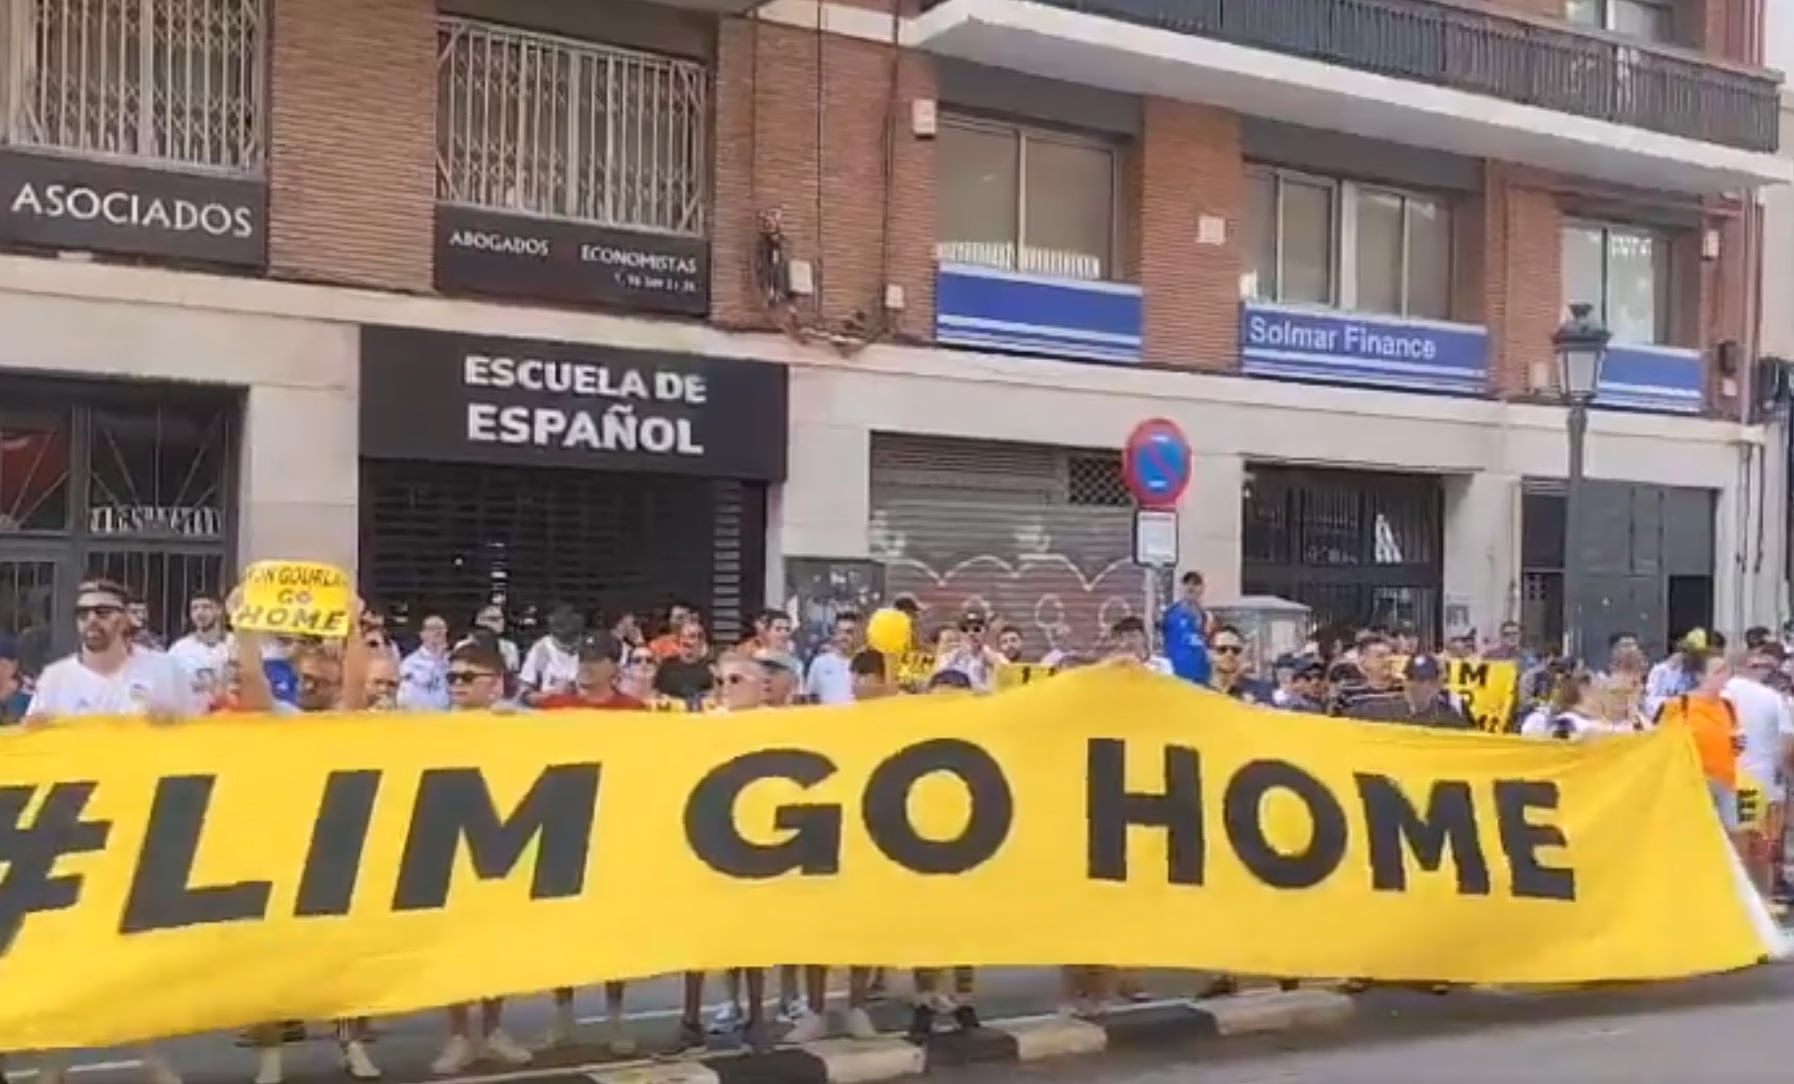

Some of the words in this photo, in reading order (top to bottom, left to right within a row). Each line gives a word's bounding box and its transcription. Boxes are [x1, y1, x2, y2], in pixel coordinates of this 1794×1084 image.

[11, 182, 253, 238] ASOCIADOS
[448, 231, 549, 256] ABOGADOS
[581, 244, 696, 274] ECONOMISTAS
[1250, 315, 1337, 350] Solmar
[1344, 325, 1437, 360] Finance
[465, 356, 649, 398] ESCUELA
[655, 371, 707, 403] DE
[468, 403, 704, 455] ESPAÑOL
[236, 605, 346, 630] HOME
[277, 588, 312, 604] GO
[0, 762, 602, 958] #LIM
[683, 738, 1013, 879] GO
[1087, 738, 1576, 901] HOME
